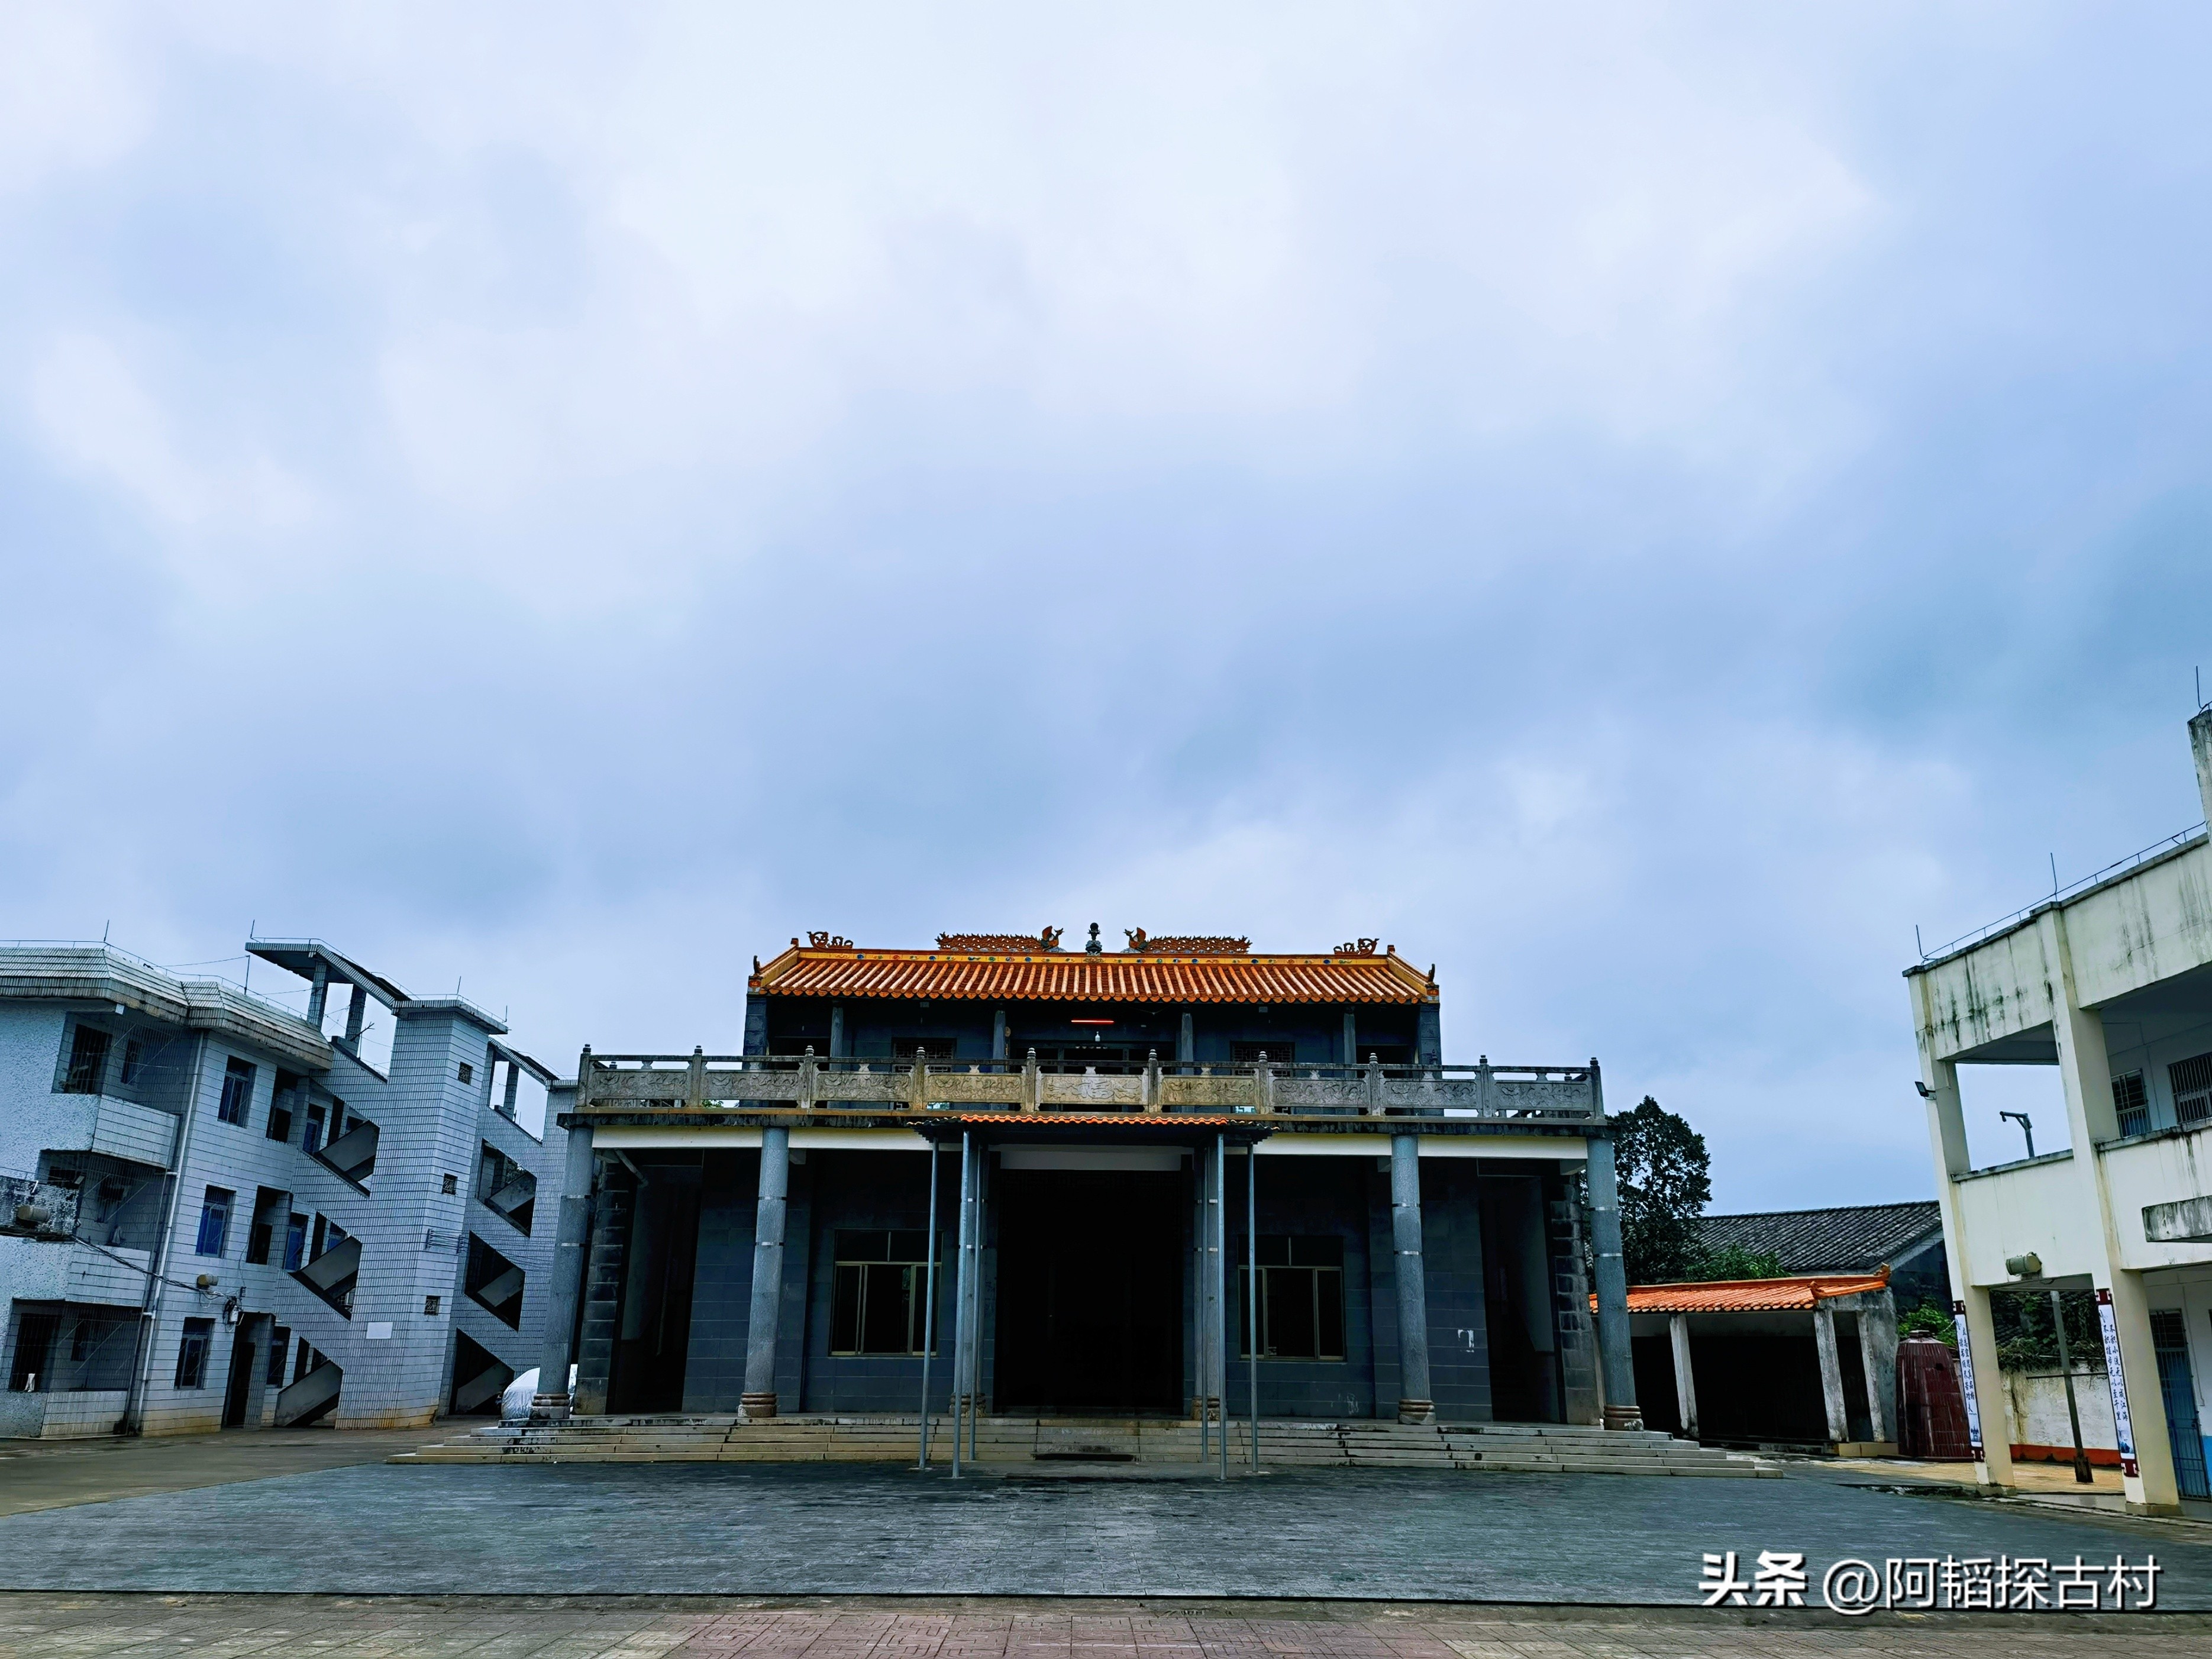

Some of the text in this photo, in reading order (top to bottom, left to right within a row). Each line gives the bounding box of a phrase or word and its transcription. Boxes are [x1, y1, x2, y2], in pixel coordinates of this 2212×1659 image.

[2103, 1324, 2121, 1421] 不积跬步无以至千里
[2110, 1324, 2128, 1422] 不积小流无以成江海
